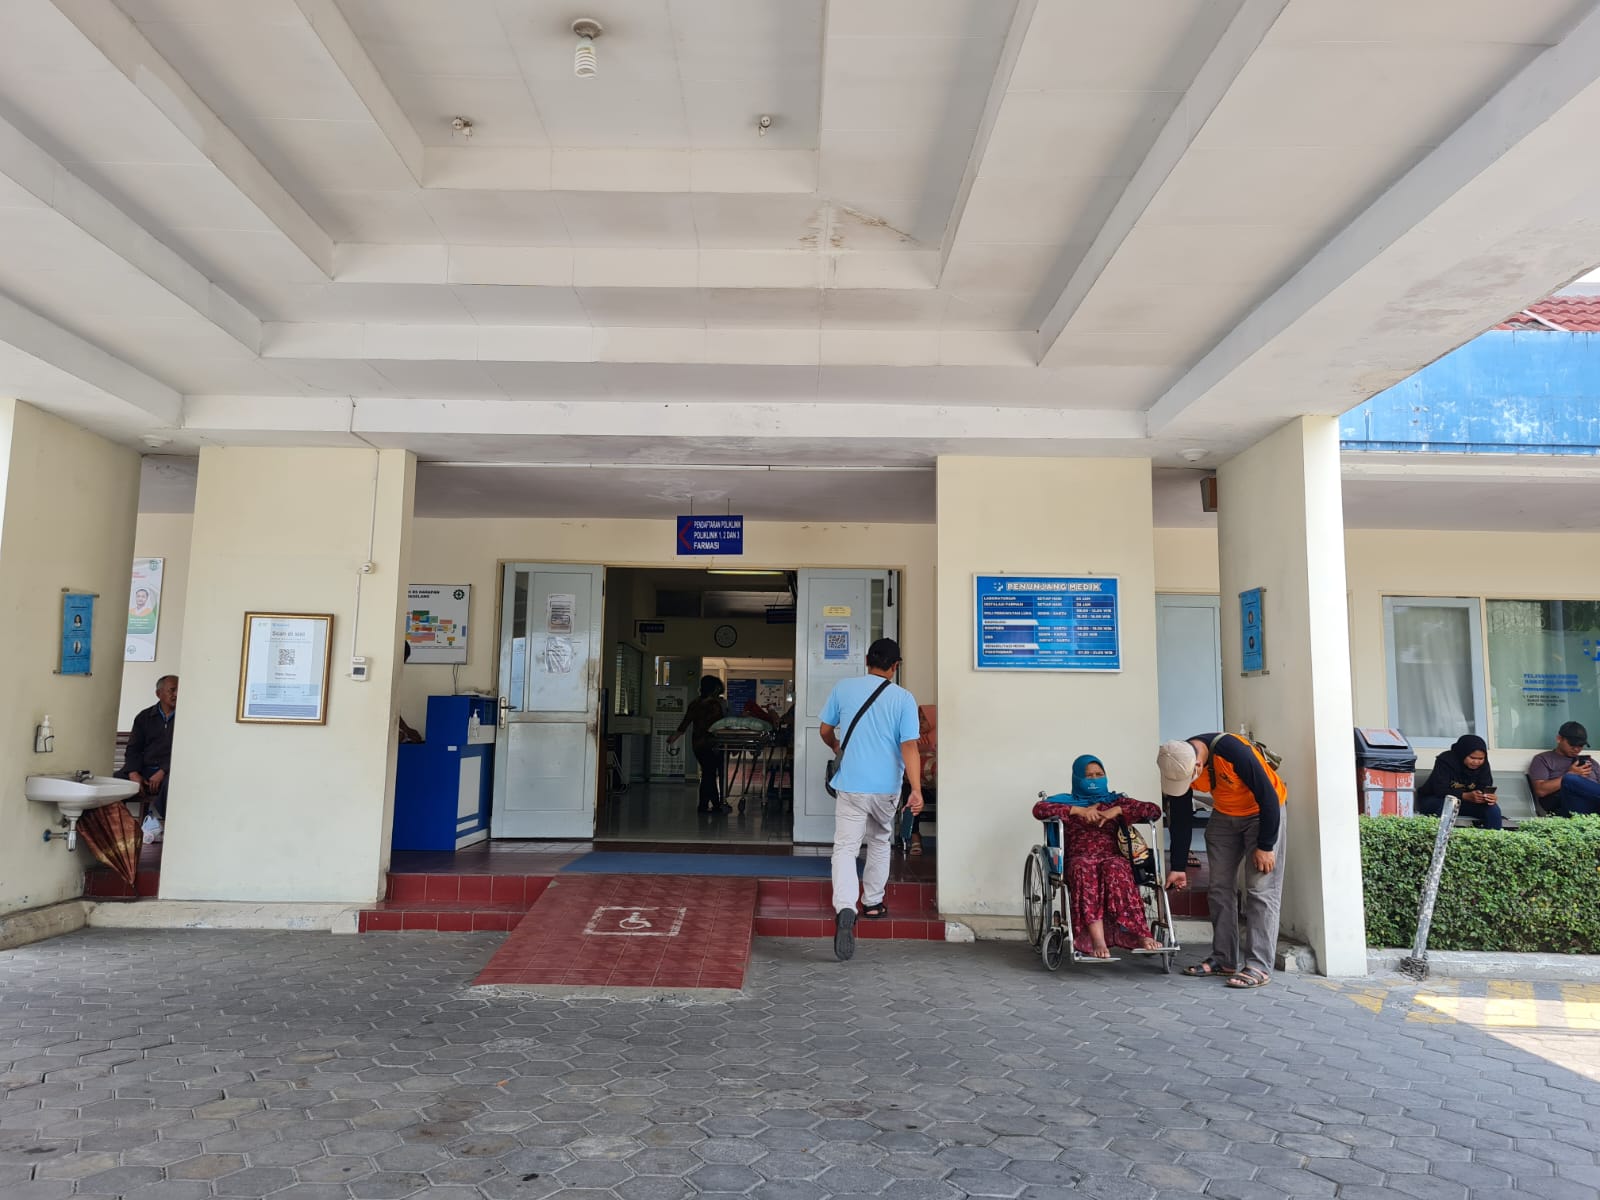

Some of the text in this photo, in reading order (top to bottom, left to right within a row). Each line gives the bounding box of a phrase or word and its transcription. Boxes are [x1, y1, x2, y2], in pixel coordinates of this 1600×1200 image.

[693, 520, 741, 529] PENDAFTARAN POLIKLINIK
[693, 531, 718, 539] POLIKLINIK
[727, 531, 736, 539] DAN
[693, 541, 720, 550] FARMASI
[1006, 582, 1102, 591] PENUNJANG MEDIK
